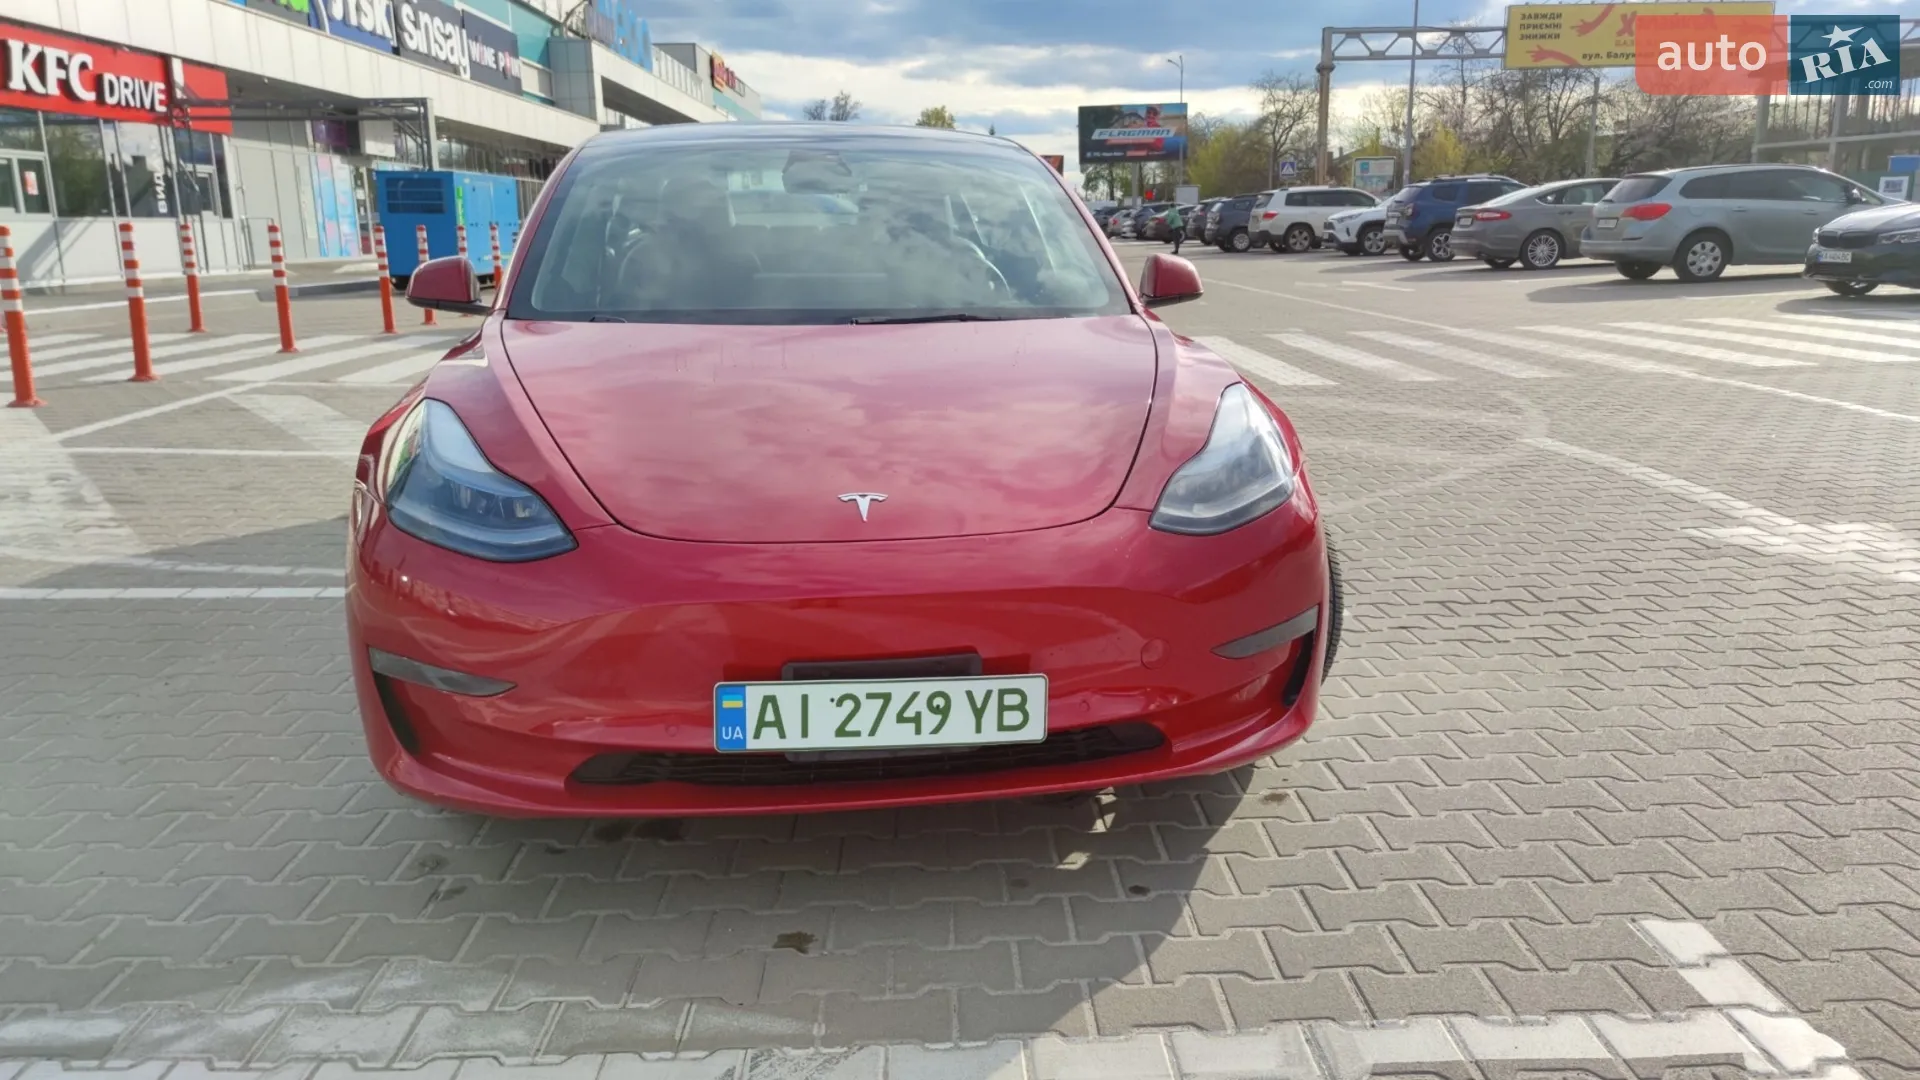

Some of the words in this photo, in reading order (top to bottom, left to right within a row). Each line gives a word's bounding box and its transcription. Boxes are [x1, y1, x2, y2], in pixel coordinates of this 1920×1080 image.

[1520, 12, 1562, 21] ЗАВЖДИ
[1519, 22, 1562, 31] ПРИЄМНІ
[1519, 32, 1561, 41] ЗНИЖКИ
[468, 38, 497, 69] WINE
[1582, 52, 1603, 60] вул.
[7, 39, 96, 102] KFC
[103, 72, 168, 112] DRIVE
[752, 693, 809, 741] AI
[834, 690, 953, 738] 2749
[965, 687, 1030, 735] YB
[721, 725, 744, 741] UA
